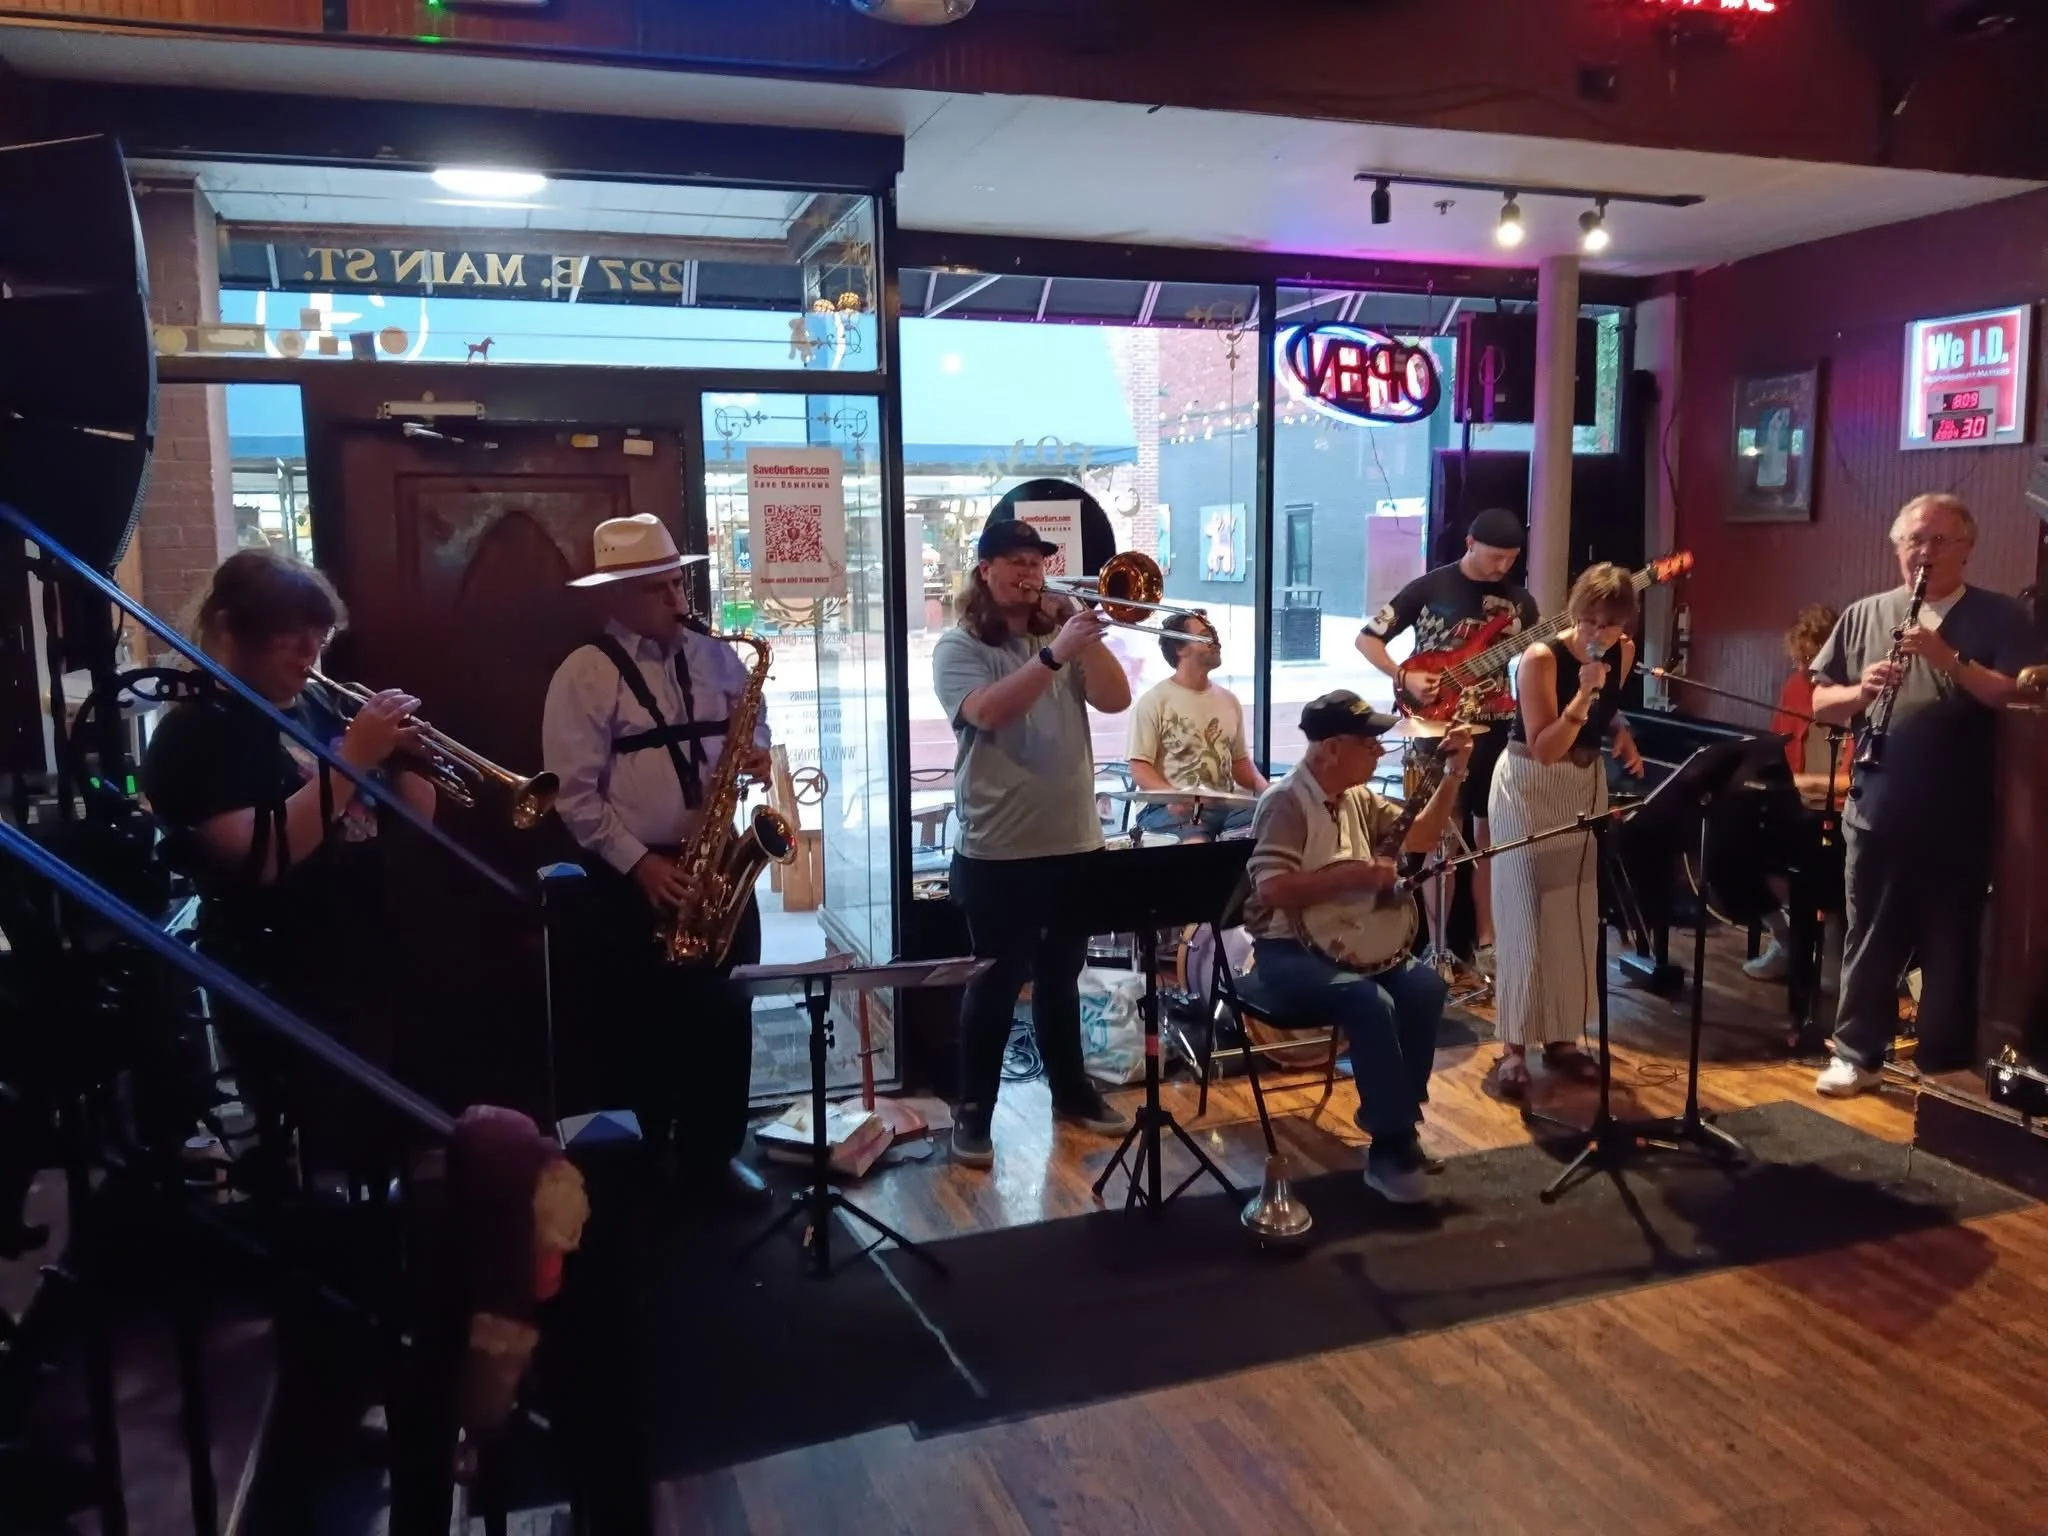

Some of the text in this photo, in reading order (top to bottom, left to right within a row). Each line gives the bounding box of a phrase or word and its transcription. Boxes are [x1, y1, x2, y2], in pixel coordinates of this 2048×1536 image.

[1928, 326, 2010, 371] We I.D.
[1961, 417, 1985, 438] 30
[753, 464, 830, 476] SaveOurBars.com
[754, 480, 830, 489] Save Downtown
